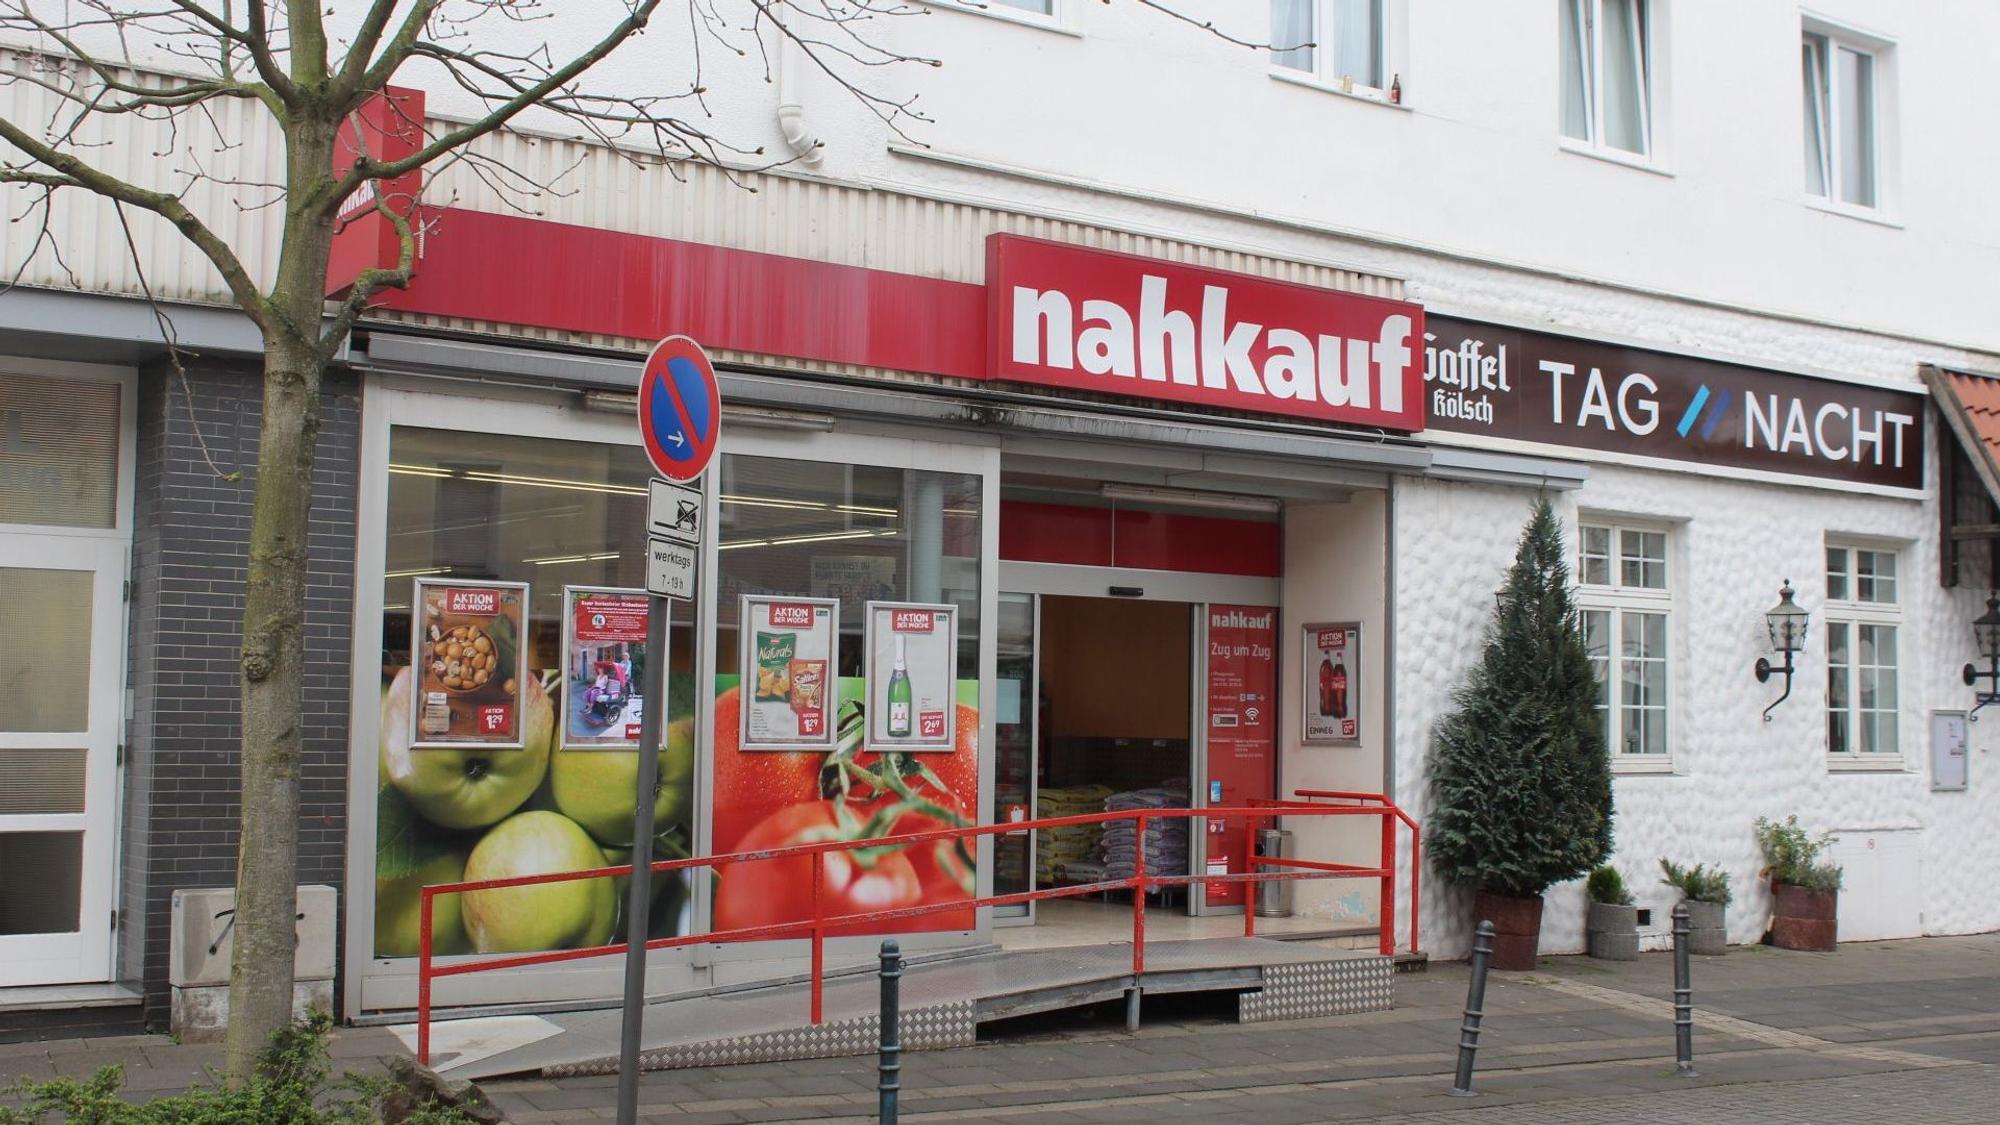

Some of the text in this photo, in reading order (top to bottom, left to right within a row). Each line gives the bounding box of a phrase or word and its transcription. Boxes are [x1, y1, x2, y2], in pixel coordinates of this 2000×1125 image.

[1013, 274, 1411, 413] nahkauf
[1433, 388, 1493, 425] Kölsch
[1539, 360, 1659, 436] TAG
[1745, 390, 1913, 468] NACHT
[654, 551, 691, 569] werktags
[453, 592, 493, 604] AKTION
[468, 604, 494, 612] WOCHE
[775, 608, 808, 619] AKTION
[787, 617, 809, 625] WOCHE
[896, 613, 928, 623] AKTION
[1212, 611, 1271, 630] nahkauf
[1320, 632, 1342, 641] AKTION
[1211, 642, 1271, 661] Zug um Zug
